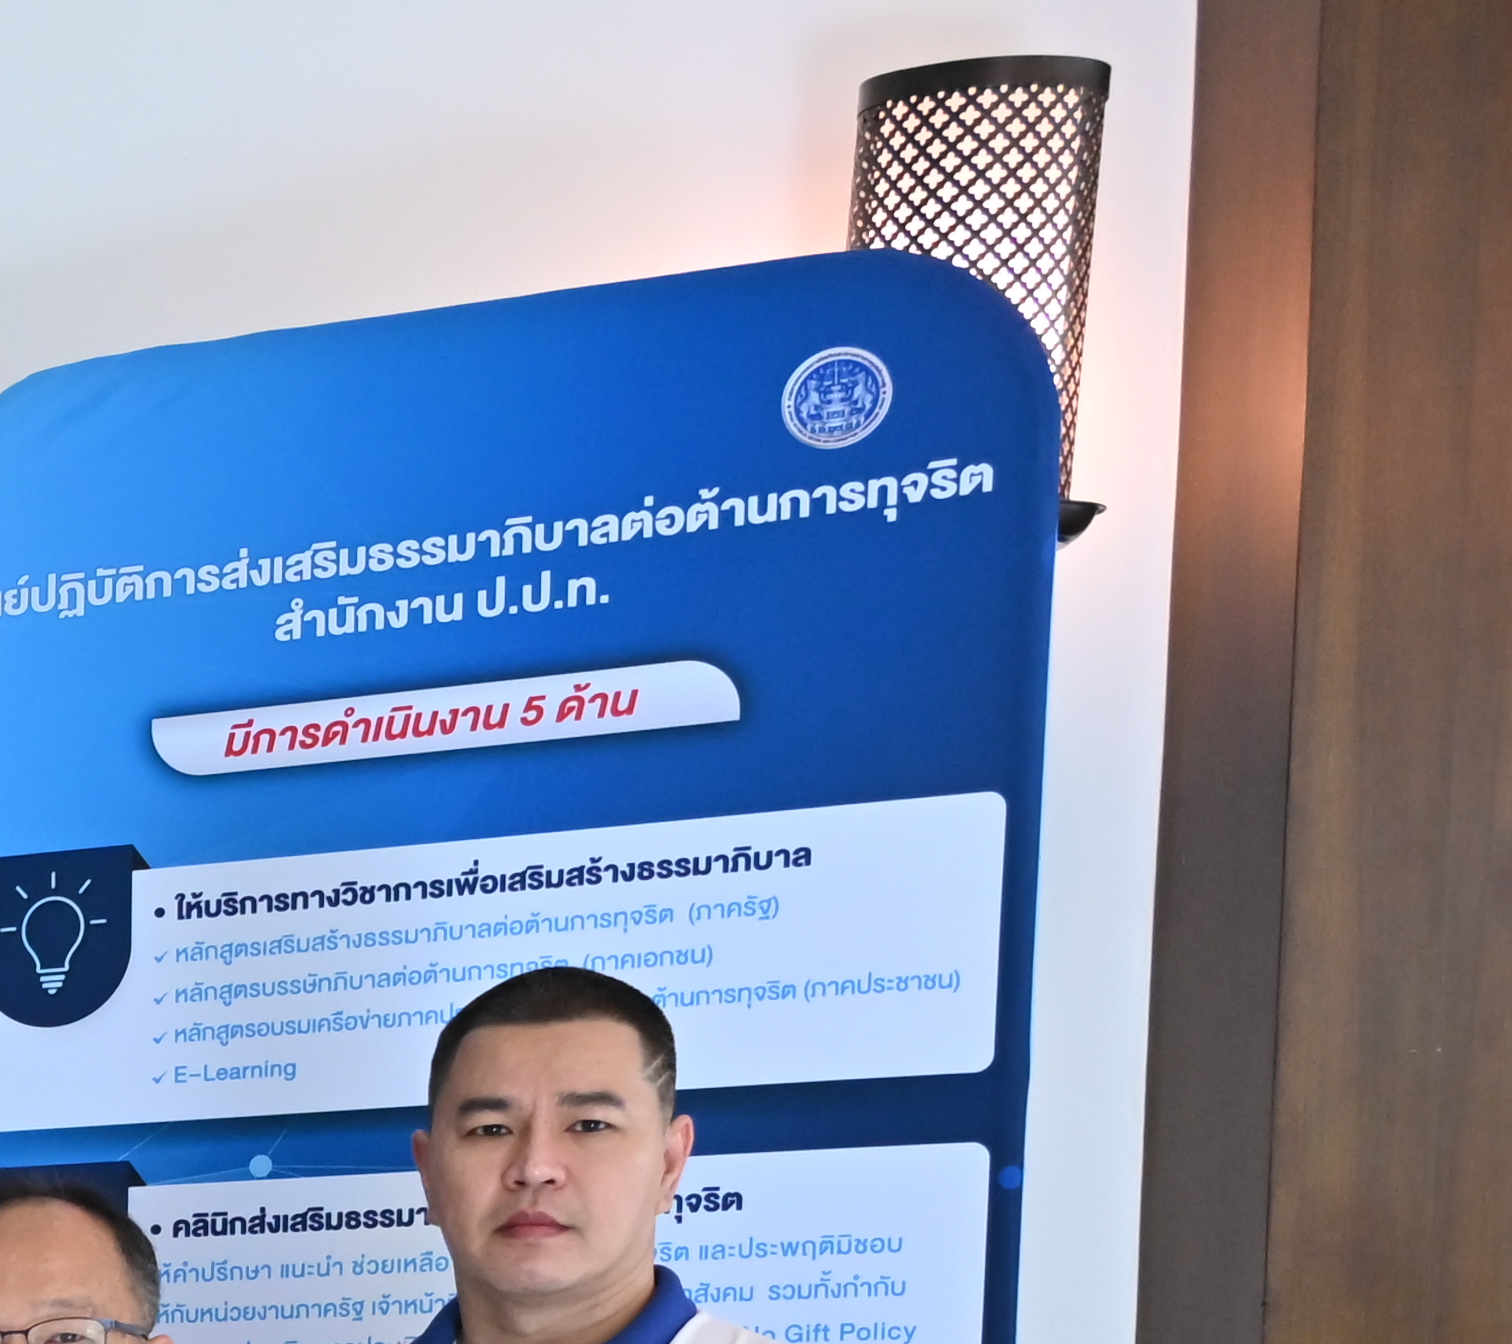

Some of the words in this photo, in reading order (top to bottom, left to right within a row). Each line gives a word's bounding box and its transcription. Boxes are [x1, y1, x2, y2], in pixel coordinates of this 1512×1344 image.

[274, 586, 464, 642] สำนักงาน
[476, 570, 610, 618] ป.ป.ท.
[223, 699, 510, 760] มีการดำเนินงาน
[519, 695, 547, 727] 5
[555, 683, 639, 724] ด้าน
[174, 845, 812, 921] ให้บริการทางวิชาการเพื่อเสริมสร้างธรรมาภิบาล
[174, 903, 674, 966] หลักสูตรเสริมสร้างธรรมาภิบาลต่อต้านการทุจริต
[687, 894, 780, 927] (ภาครัฐ)
[583, 943, 714, 973] (ภาคเอกชน)
[803, 969, 962, 1003] (ภาคประชาชน)
[279, 1254, 344, 1280] แนะนำ
[698, 1233, 904, 1261] และประพฤติมิชอบ
[767, 1270, 907, 1301] รวมทั้งกำกับ
[784, 1323, 831, 1344] Gift
[839, 1322, 917, 1344] Policy
